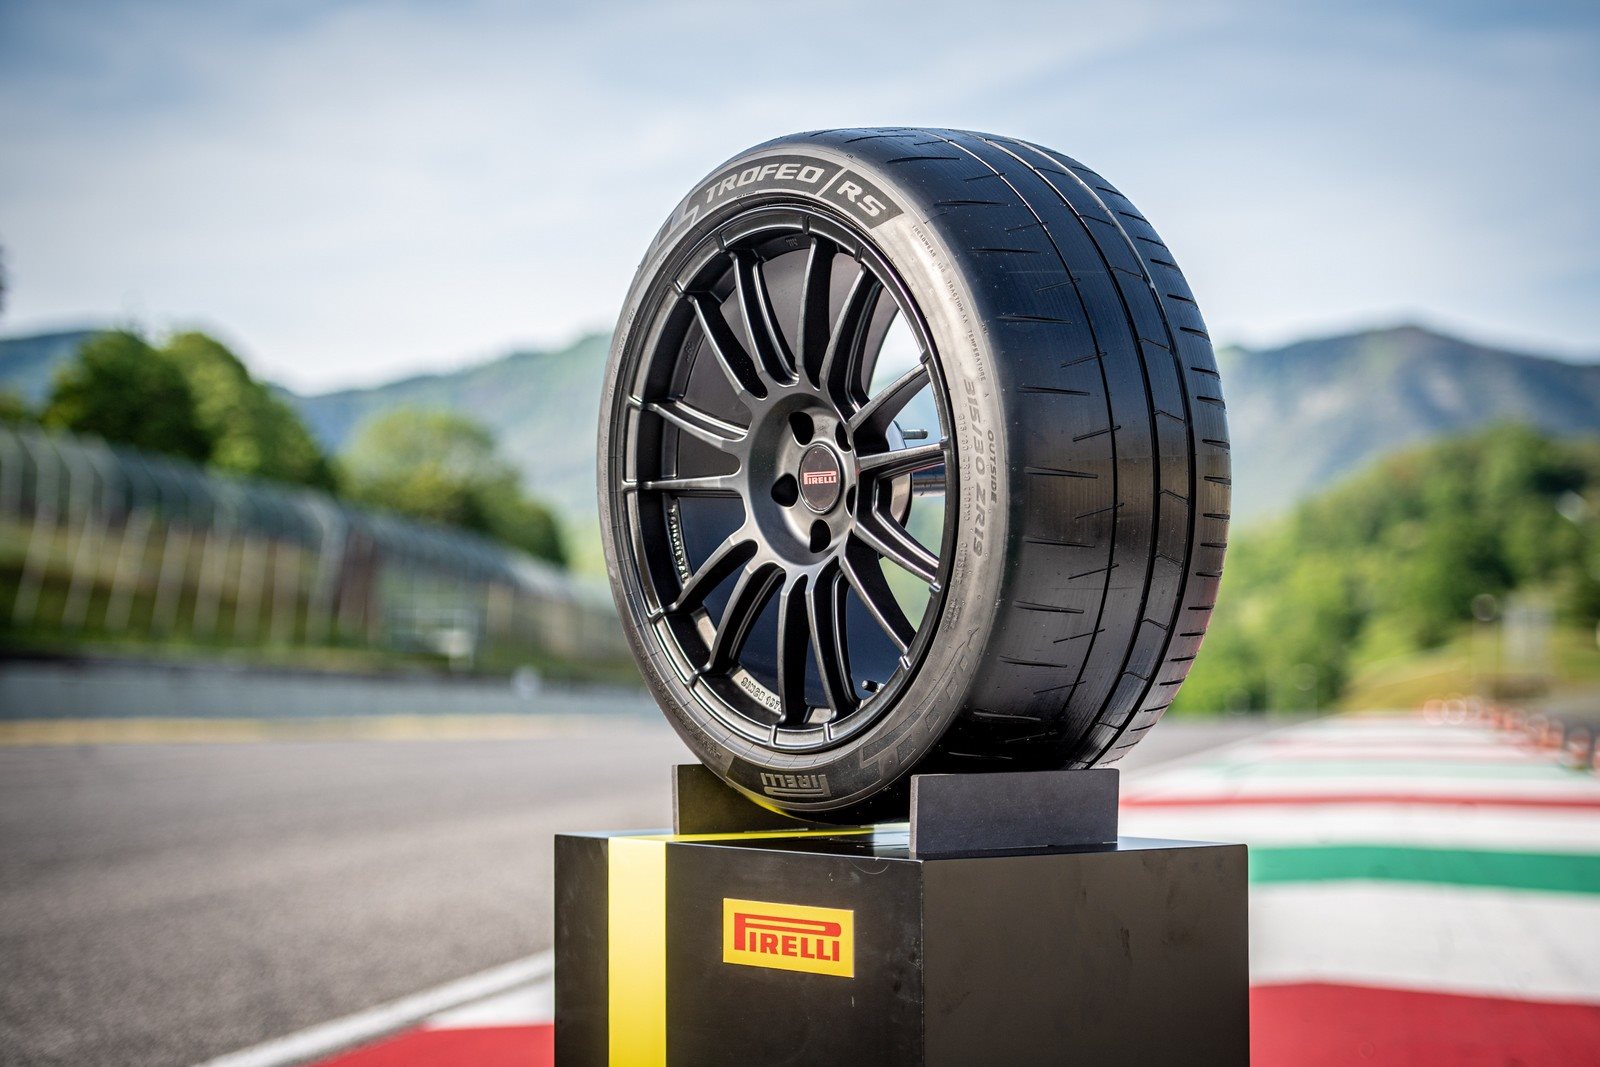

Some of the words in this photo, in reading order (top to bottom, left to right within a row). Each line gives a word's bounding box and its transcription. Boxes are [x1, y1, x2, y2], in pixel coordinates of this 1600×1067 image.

[705, 163, 825, 204] TROFEO
[836, 180, 887, 218] RS
[912, 225, 937, 258] TREADWEAR
[947, 280, 964, 312] TRACTION
[968, 329, 986, 381] TEMPERATURE
[964, 379, 985, 476] 315/30
[803, 470, 837, 485] PIRELLI
[987, 429, 997, 504] OUTSIDE
[973, 482, 986, 557] ZR19
[760, 772, 832, 798] PIRELLI
[734, 912, 842, 962] PIRELLI
